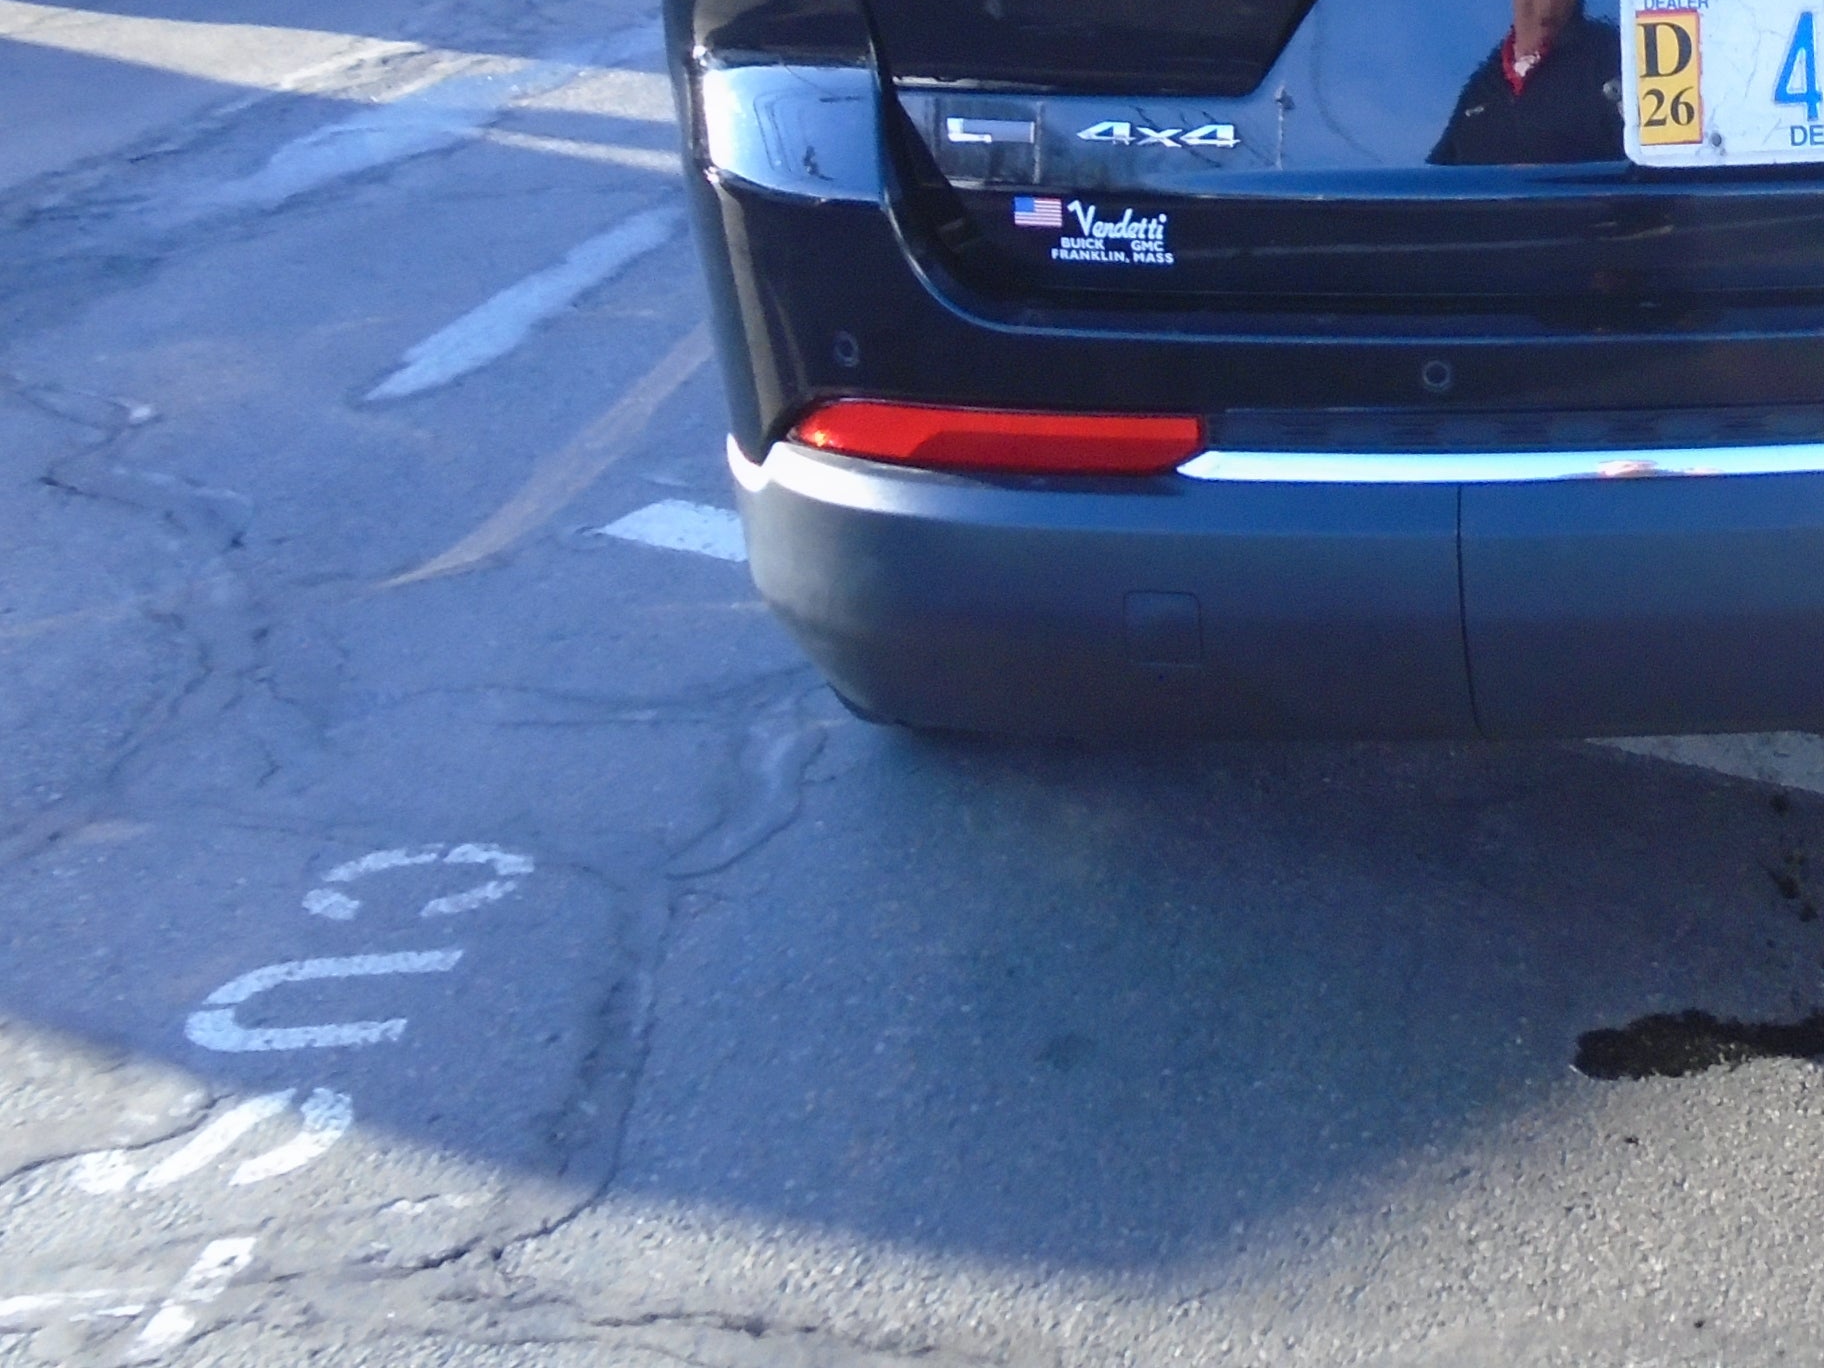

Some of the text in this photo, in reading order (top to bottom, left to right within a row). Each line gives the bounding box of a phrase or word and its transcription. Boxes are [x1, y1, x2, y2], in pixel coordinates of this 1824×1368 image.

[1639, 22, 1692, 78] D
[1642, 87, 1695, 127] 26
[1077, 120, 1240, 148] 4x4
[1067, 200, 1167, 239] Vendetti
[1061, 237, 1164, 251] BUICK GMC
[1133, 252, 1174, 263] MASS
